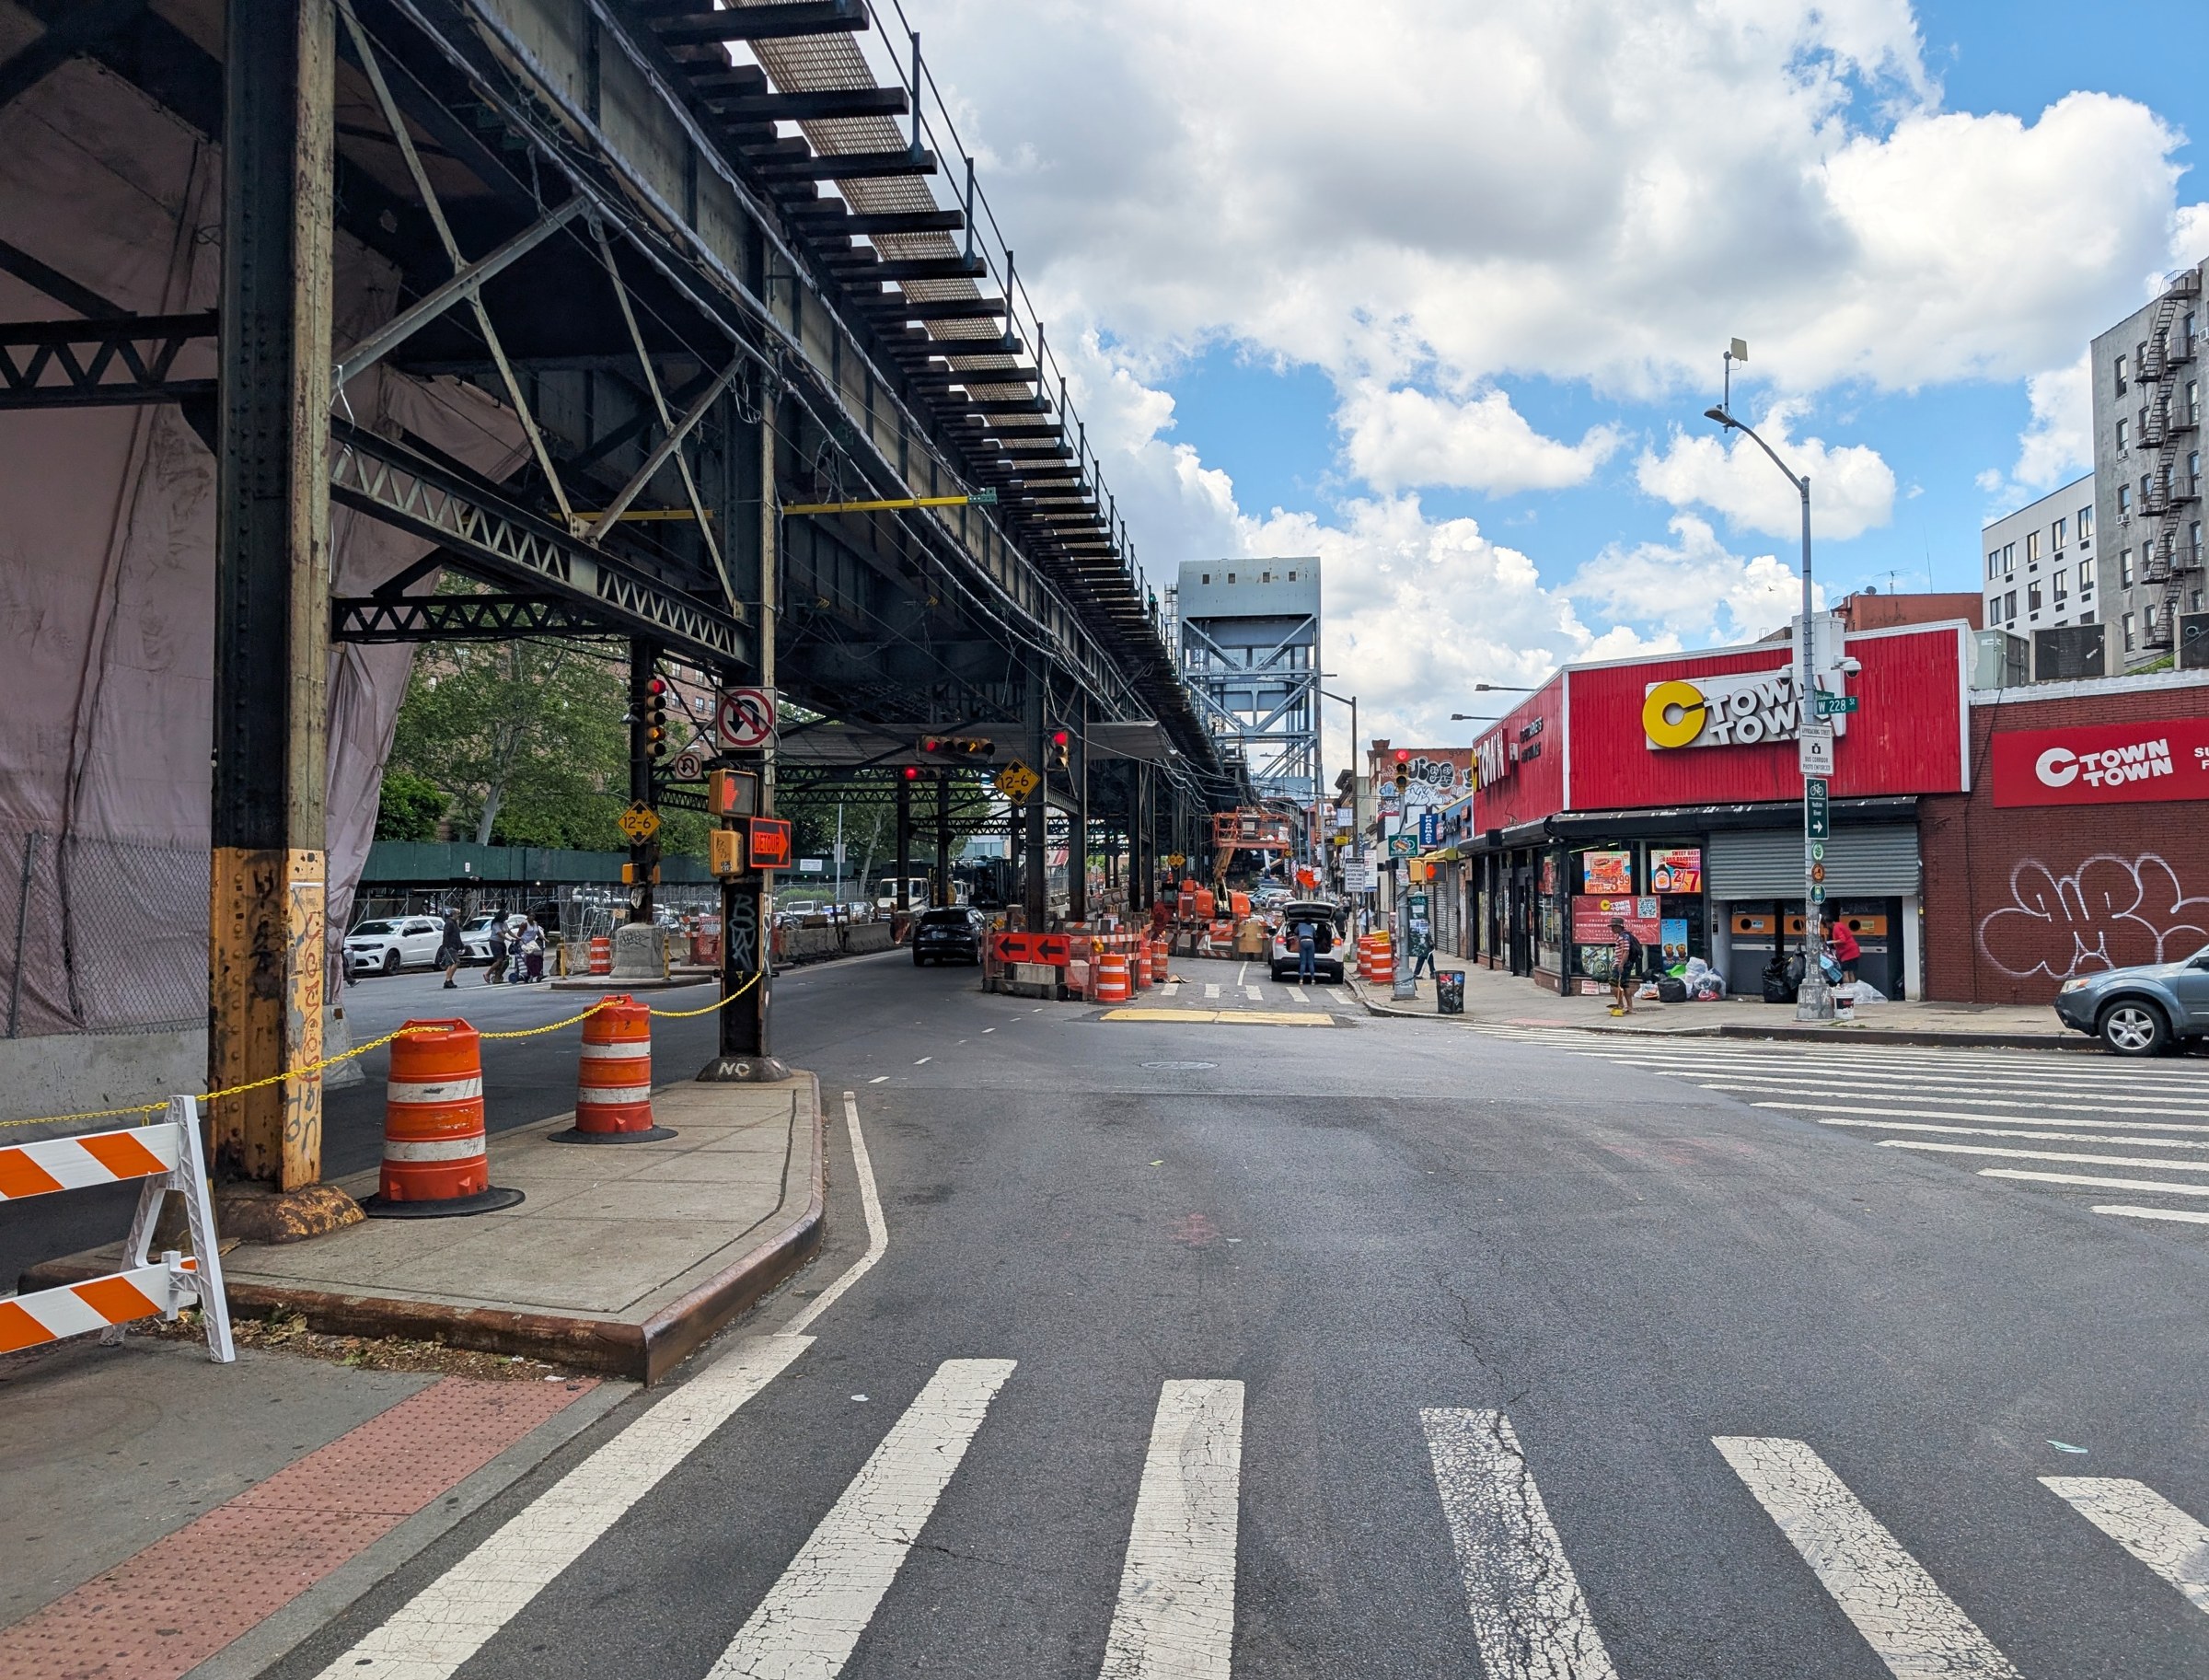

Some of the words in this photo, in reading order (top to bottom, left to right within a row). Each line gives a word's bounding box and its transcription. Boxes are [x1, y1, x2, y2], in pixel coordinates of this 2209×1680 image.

[1642, 681, 1706, 747] C
[1818, 701, 1825, 713] W
[1829, 700, 1846, 713] 228
[1477, 728, 1505, 790] TOWN
[2035, 747, 2079, 787] C
[2078, 738, 2169, 771] TOWN
[2083, 757, 2174, 787] TOWN
[623, 815, 654, 829] 12'-6"
[1425, 815, 1433, 844] PHARMACY
[755, 834, 781, 852] DETOUR
[1610, 899, 1630, 908] TOWN
